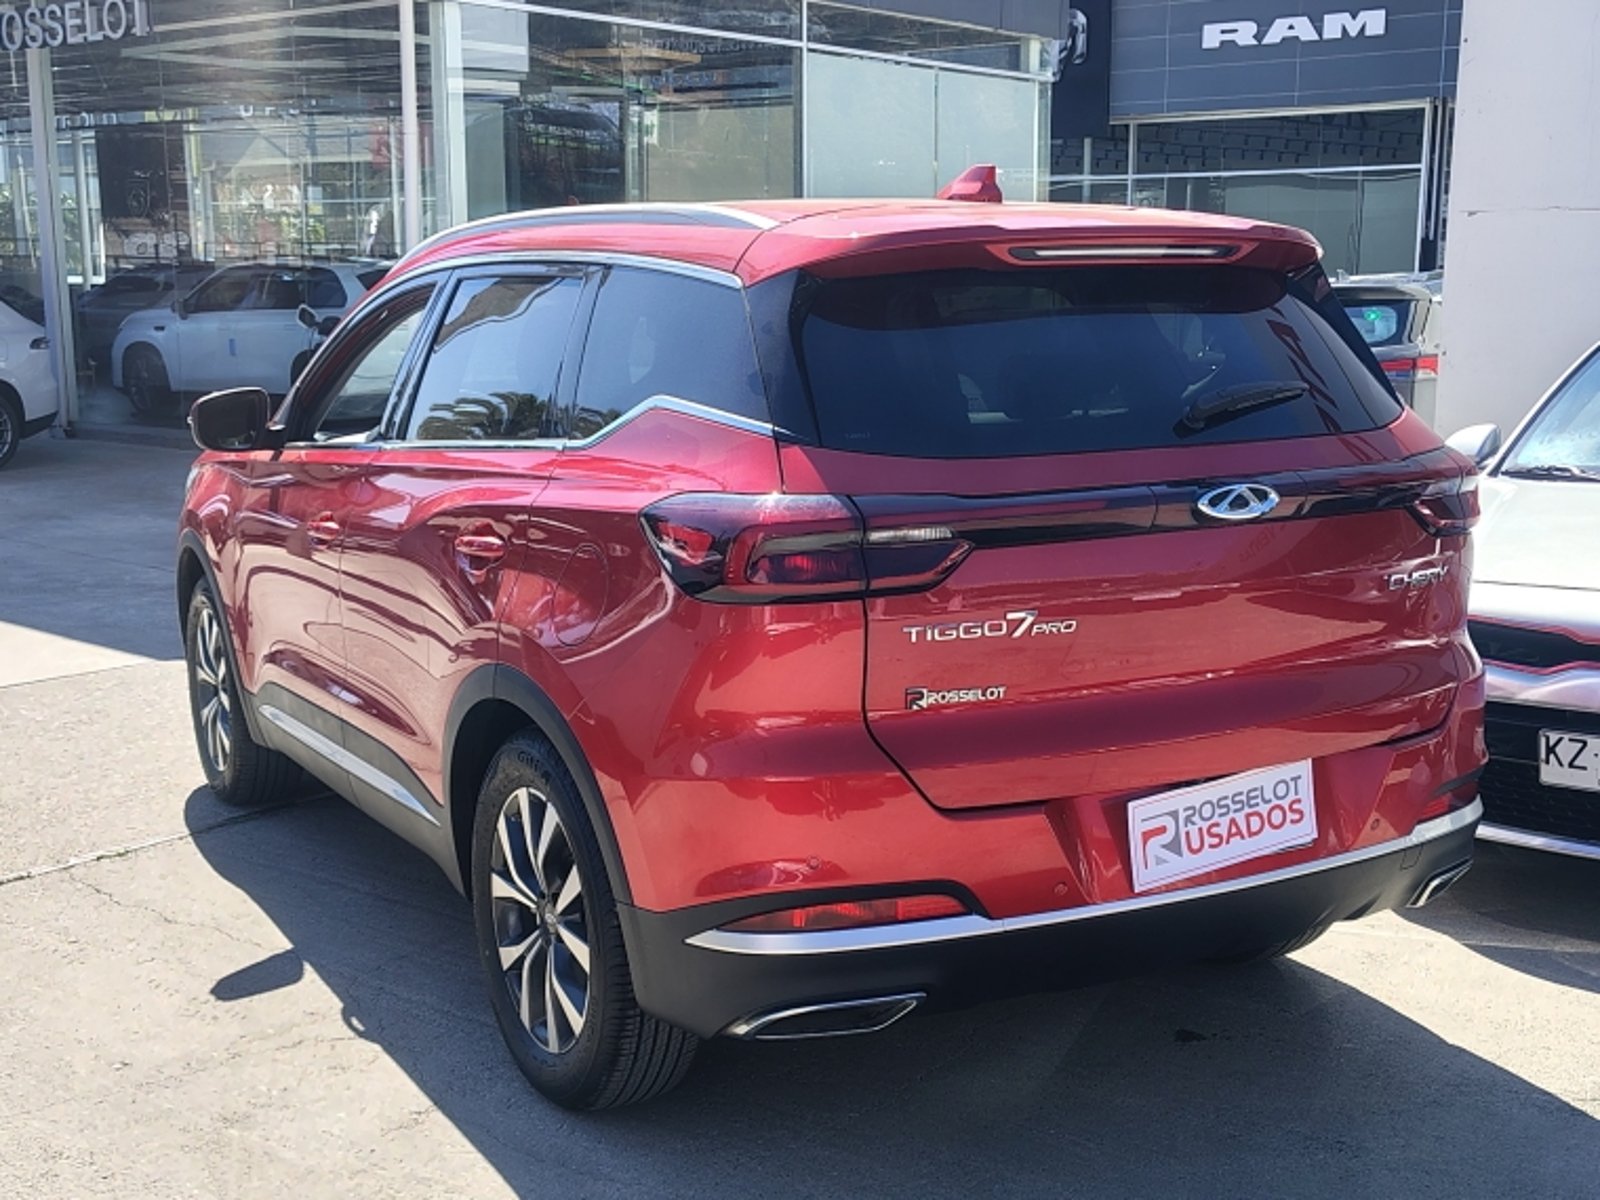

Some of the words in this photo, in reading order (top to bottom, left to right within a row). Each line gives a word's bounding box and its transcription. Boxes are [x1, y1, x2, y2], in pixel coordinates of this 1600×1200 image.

[1201, 7, 1387, 50] RAM
[1182, 774, 1303, 828] ROSSELOT
[1184, 797, 1305, 856] USADOS
